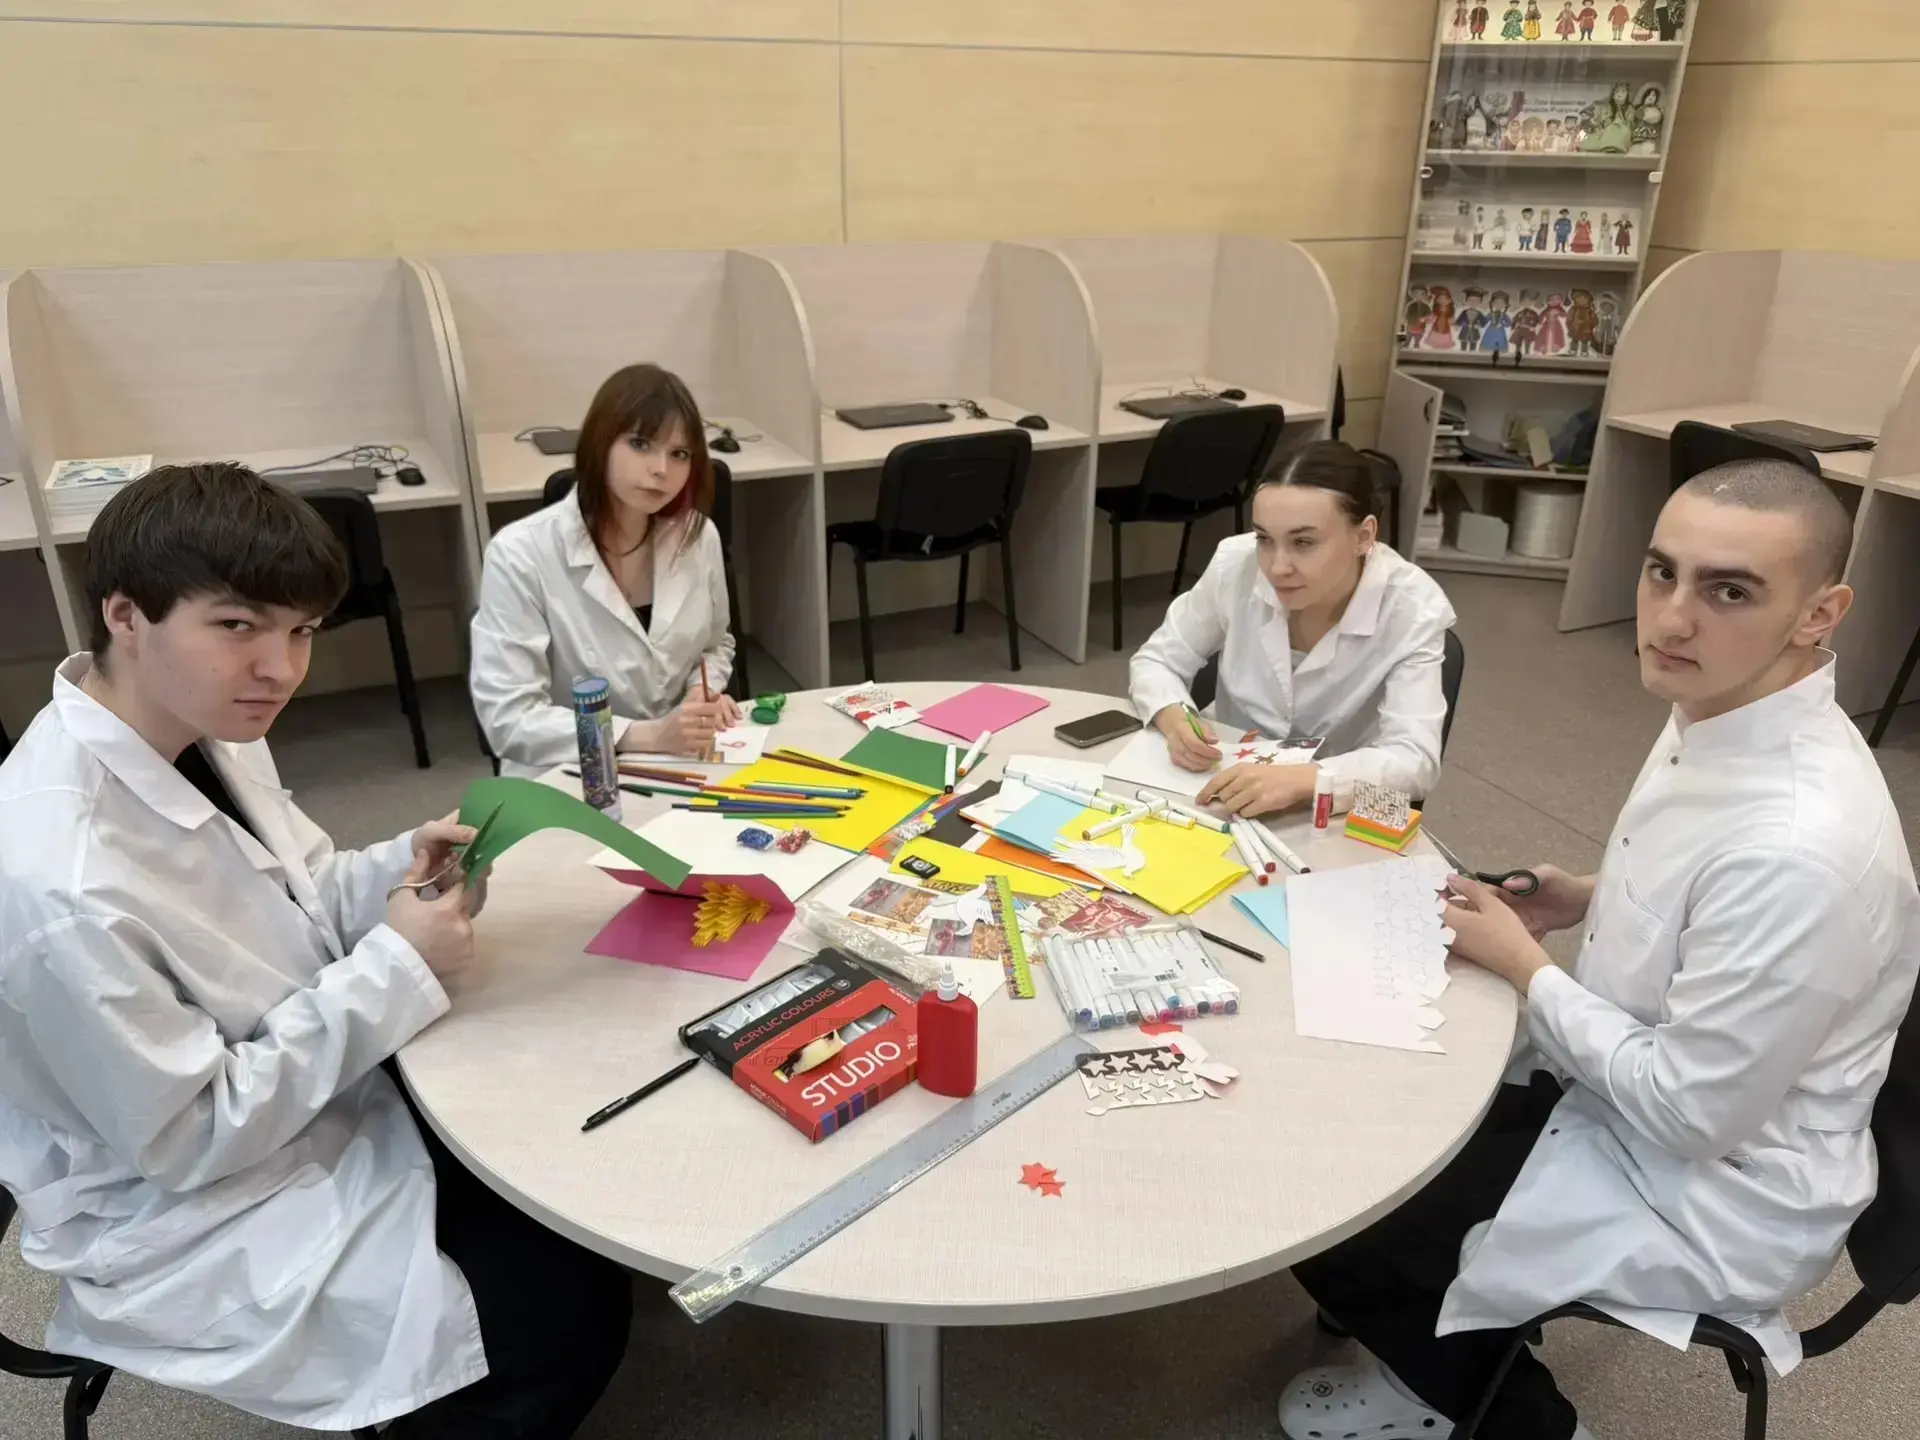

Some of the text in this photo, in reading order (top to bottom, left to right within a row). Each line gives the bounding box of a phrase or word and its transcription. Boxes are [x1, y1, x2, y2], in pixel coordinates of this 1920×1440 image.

[733, 1017, 782, 1052] ACRYLIC
[781, 987, 836, 1020] COLOURS
[801, 1040, 901, 1107] STUDIO
